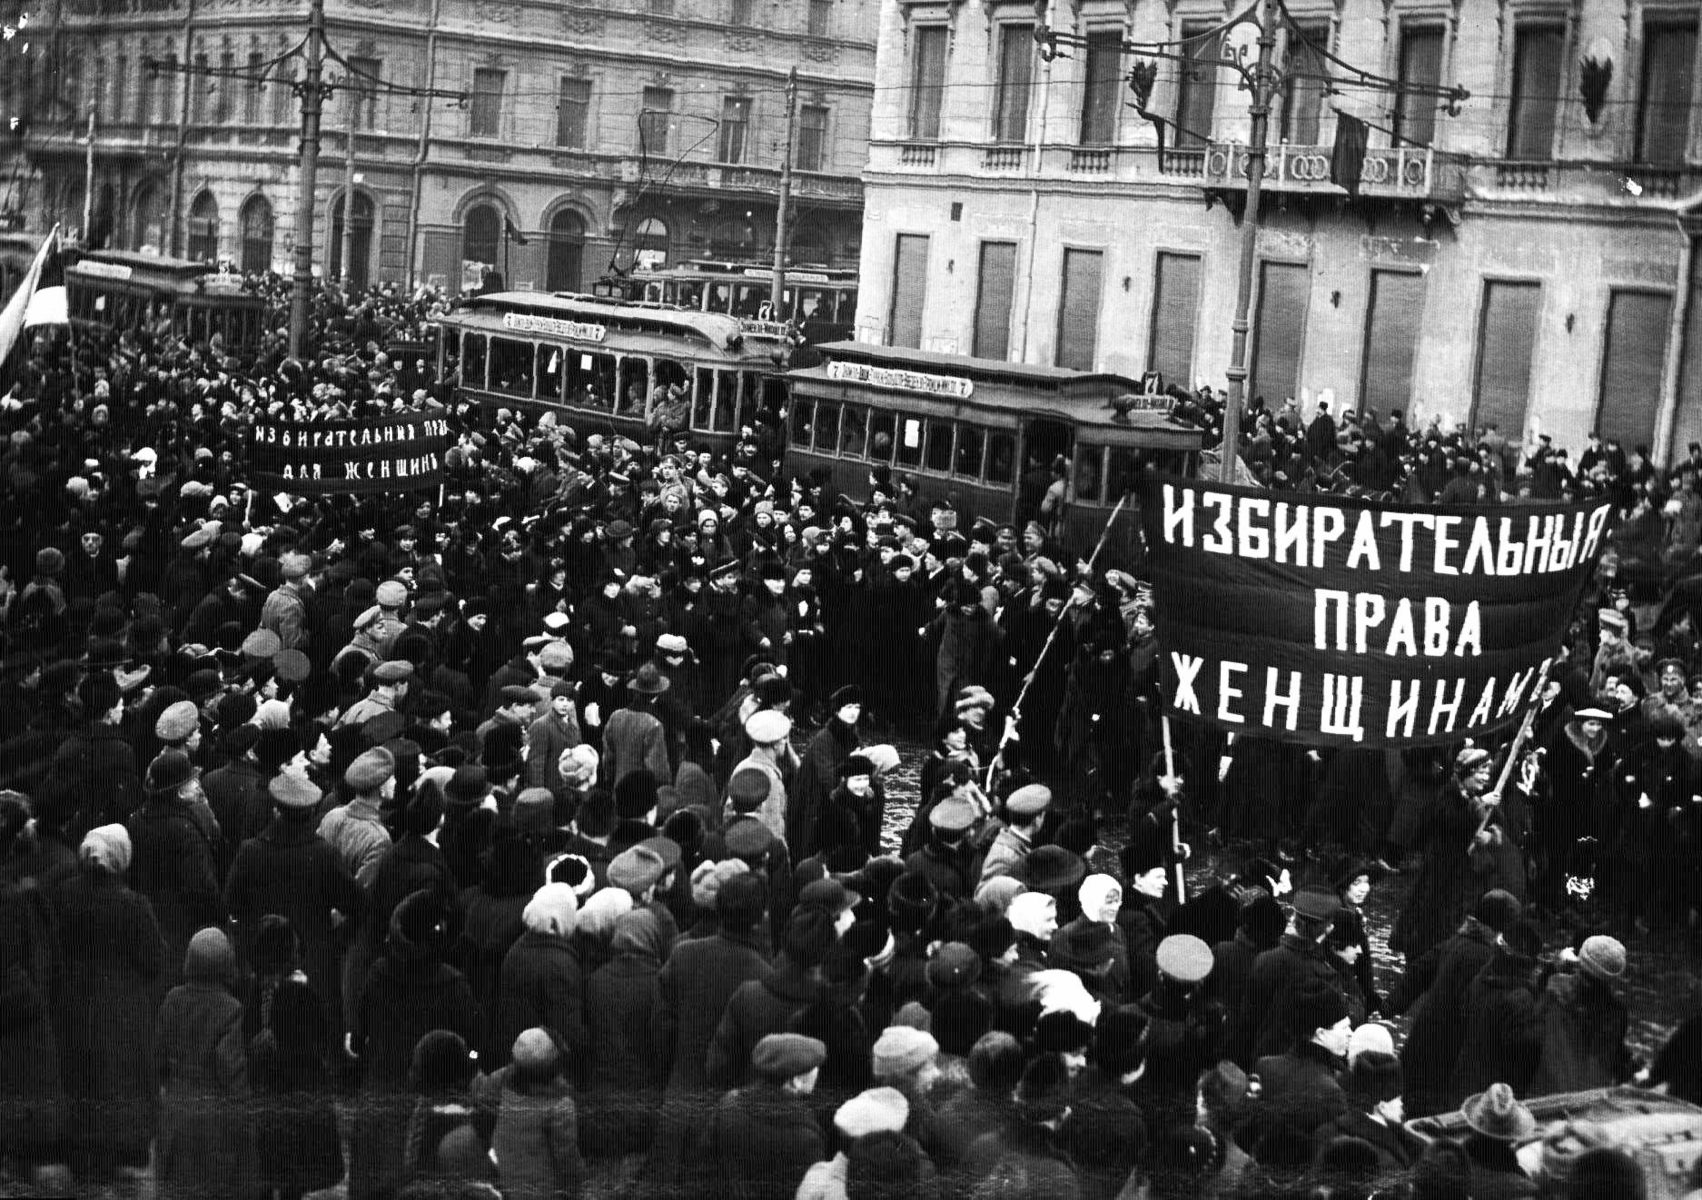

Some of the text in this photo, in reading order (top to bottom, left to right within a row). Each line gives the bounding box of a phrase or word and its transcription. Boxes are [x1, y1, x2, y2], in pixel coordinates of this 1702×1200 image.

[761, 301, 771, 319] 7
[1146, 373, 1157, 394] 7
[1163, 484, 1611, 576] ИЗБИРАТЕЛЬНЫЯ
[1314, 588, 1482, 657] ПРАВА
